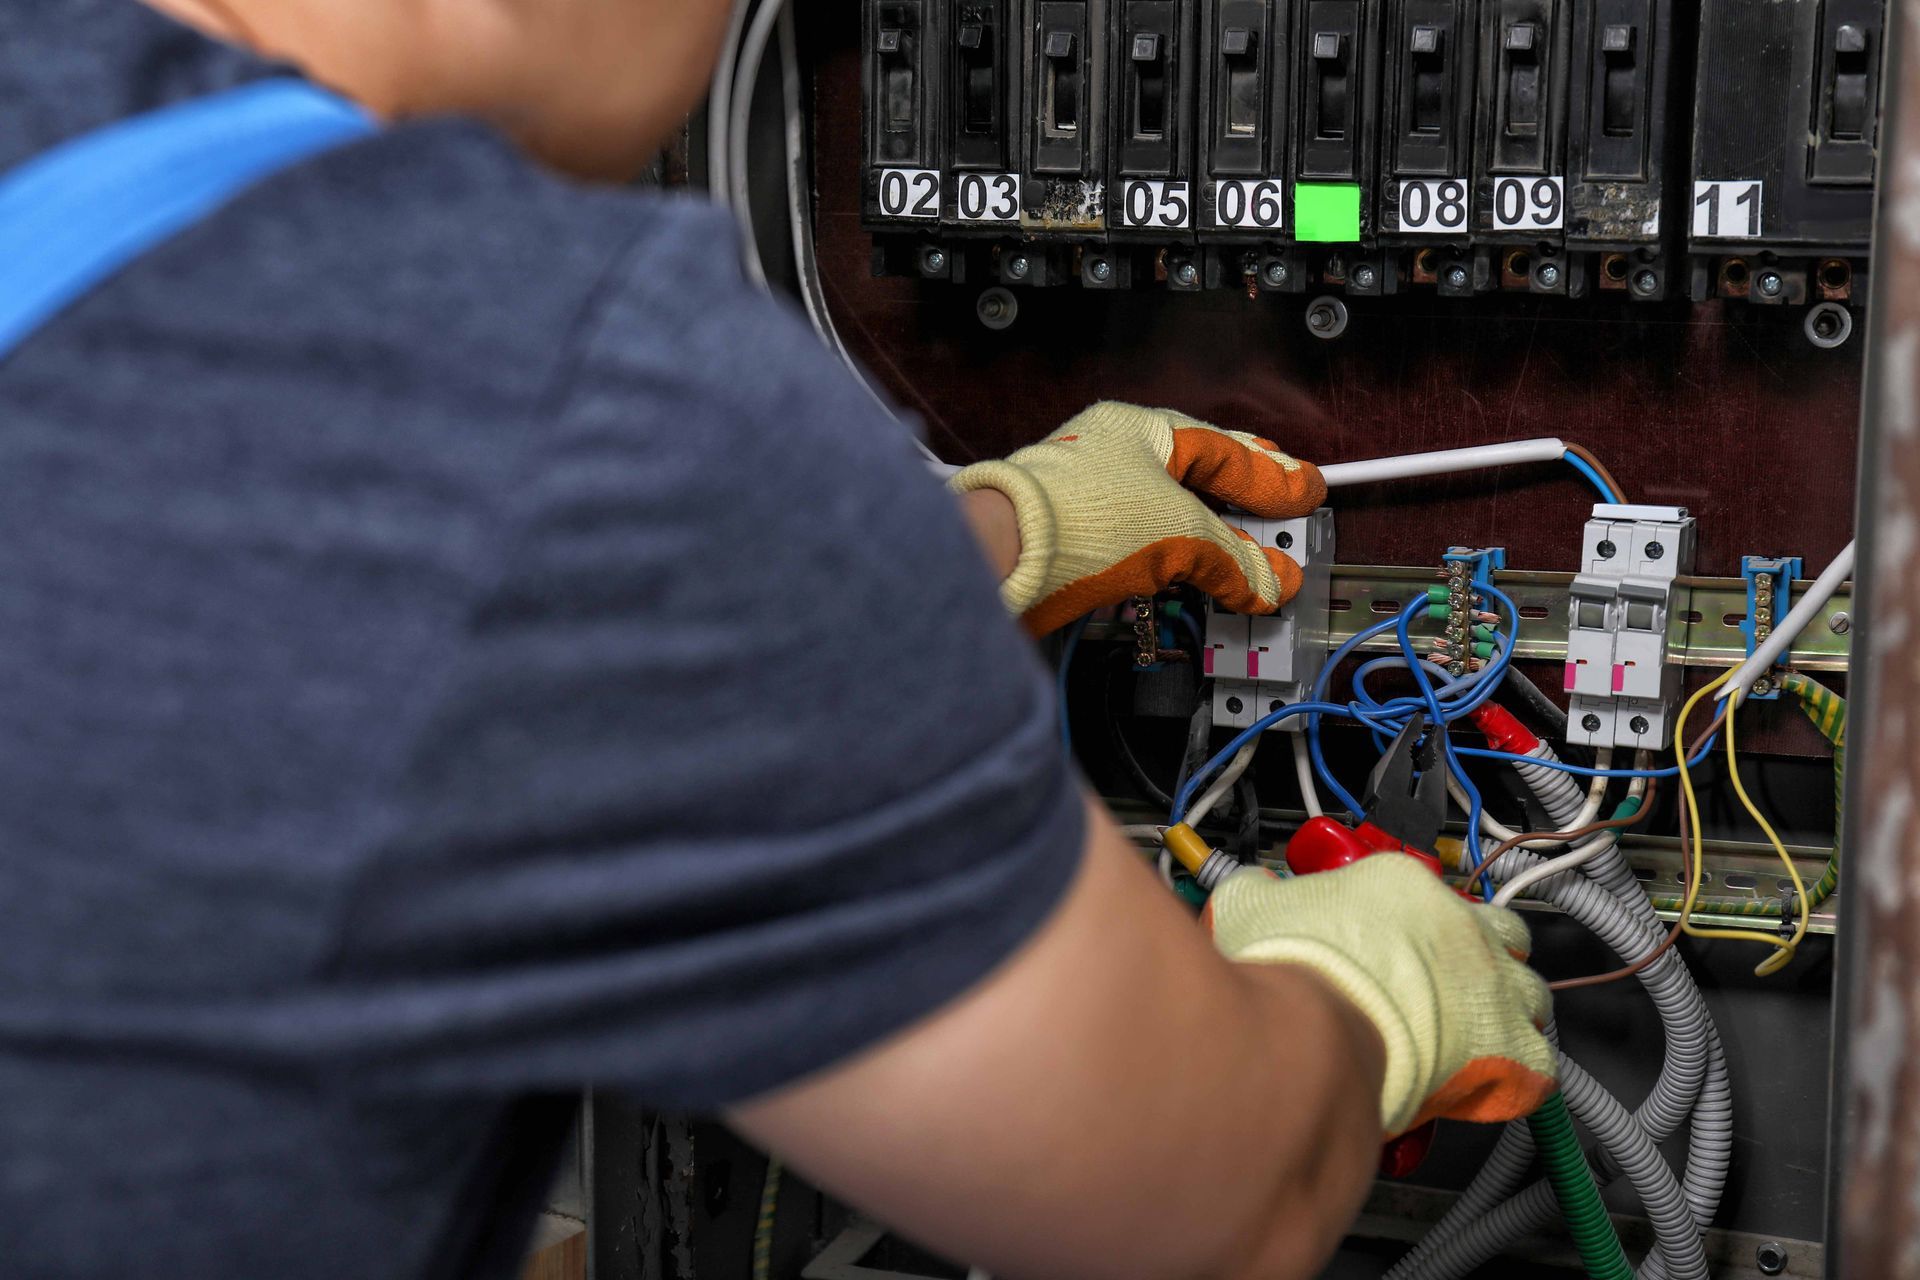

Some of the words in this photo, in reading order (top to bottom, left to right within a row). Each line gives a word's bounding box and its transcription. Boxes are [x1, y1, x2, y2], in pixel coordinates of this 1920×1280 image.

[881, 171, 939, 216] 02
[960, 174, 1018, 219] 03
[1126, 180, 1187, 227] 05
[1218, 180, 1280, 227] 06
[1401, 181, 1466, 228] 08
[1495, 178, 1561, 225] 09
[1696, 184, 1760, 235] 11
